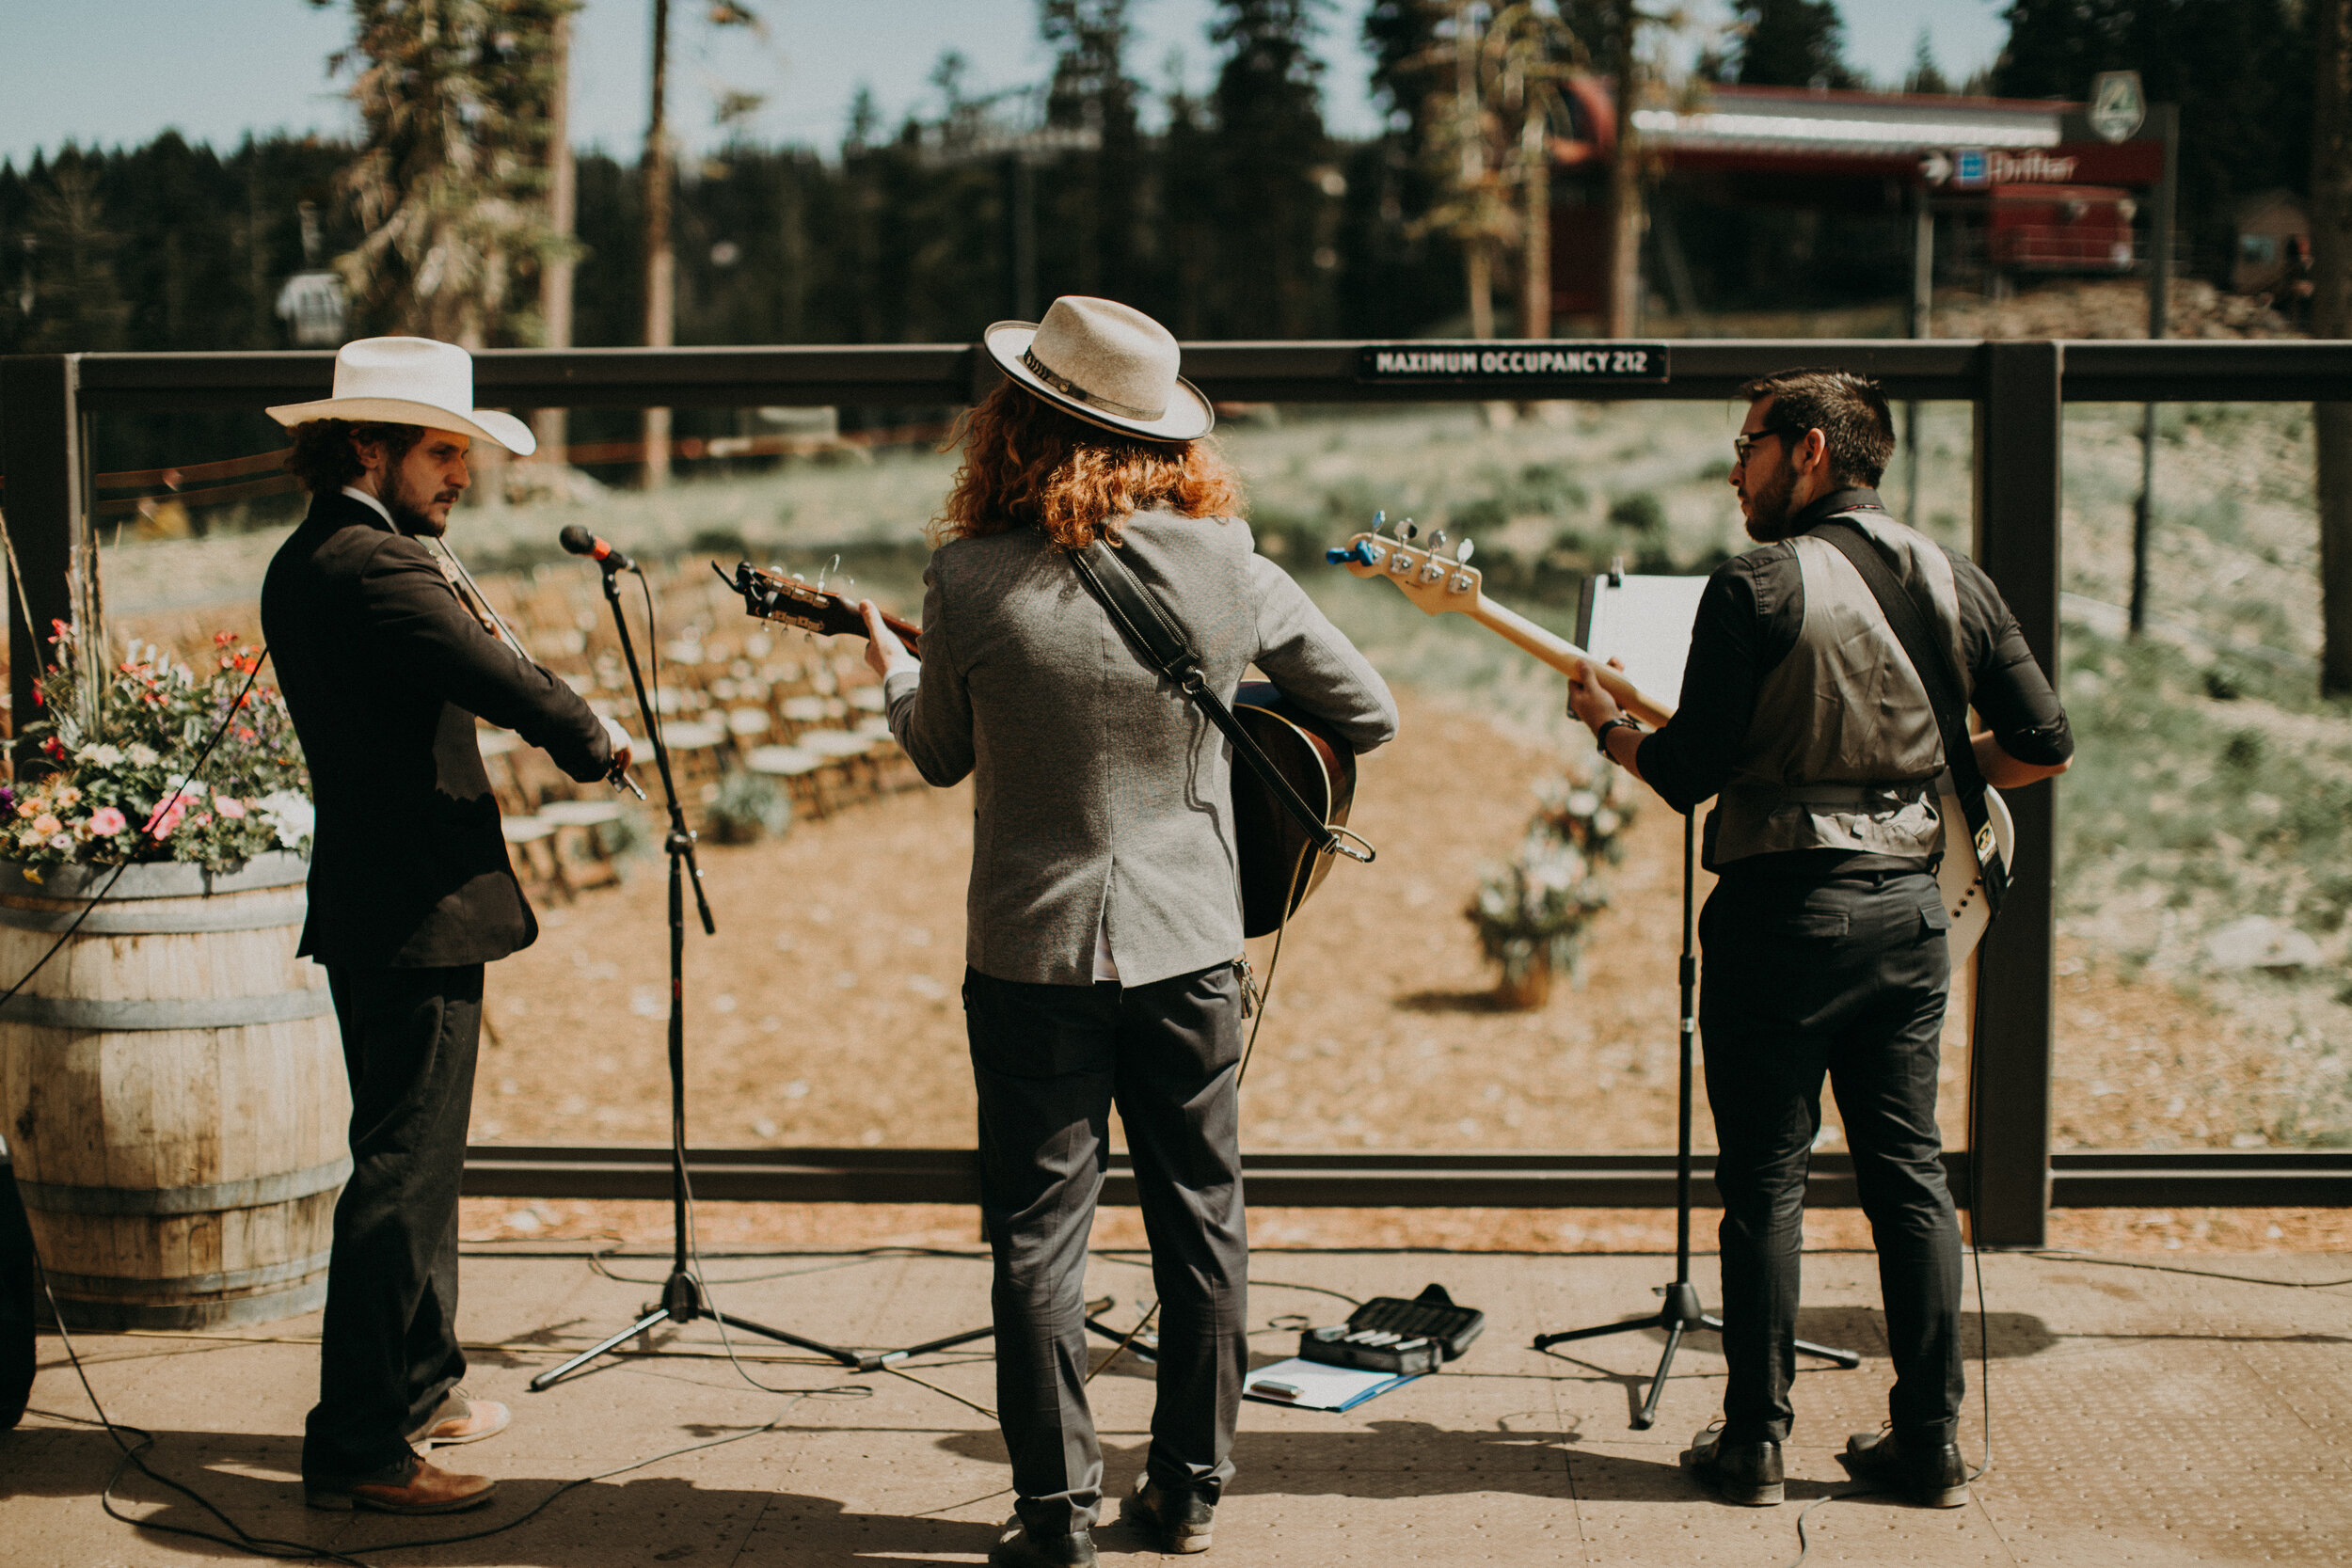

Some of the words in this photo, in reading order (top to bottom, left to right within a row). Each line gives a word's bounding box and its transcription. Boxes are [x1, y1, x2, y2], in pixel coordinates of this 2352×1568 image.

[1376, 352, 1477, 372] MAXIMUM
[1481, 351, 1610, 372] OCCUPANCY
[1613, 351, 1647, 372] 212
